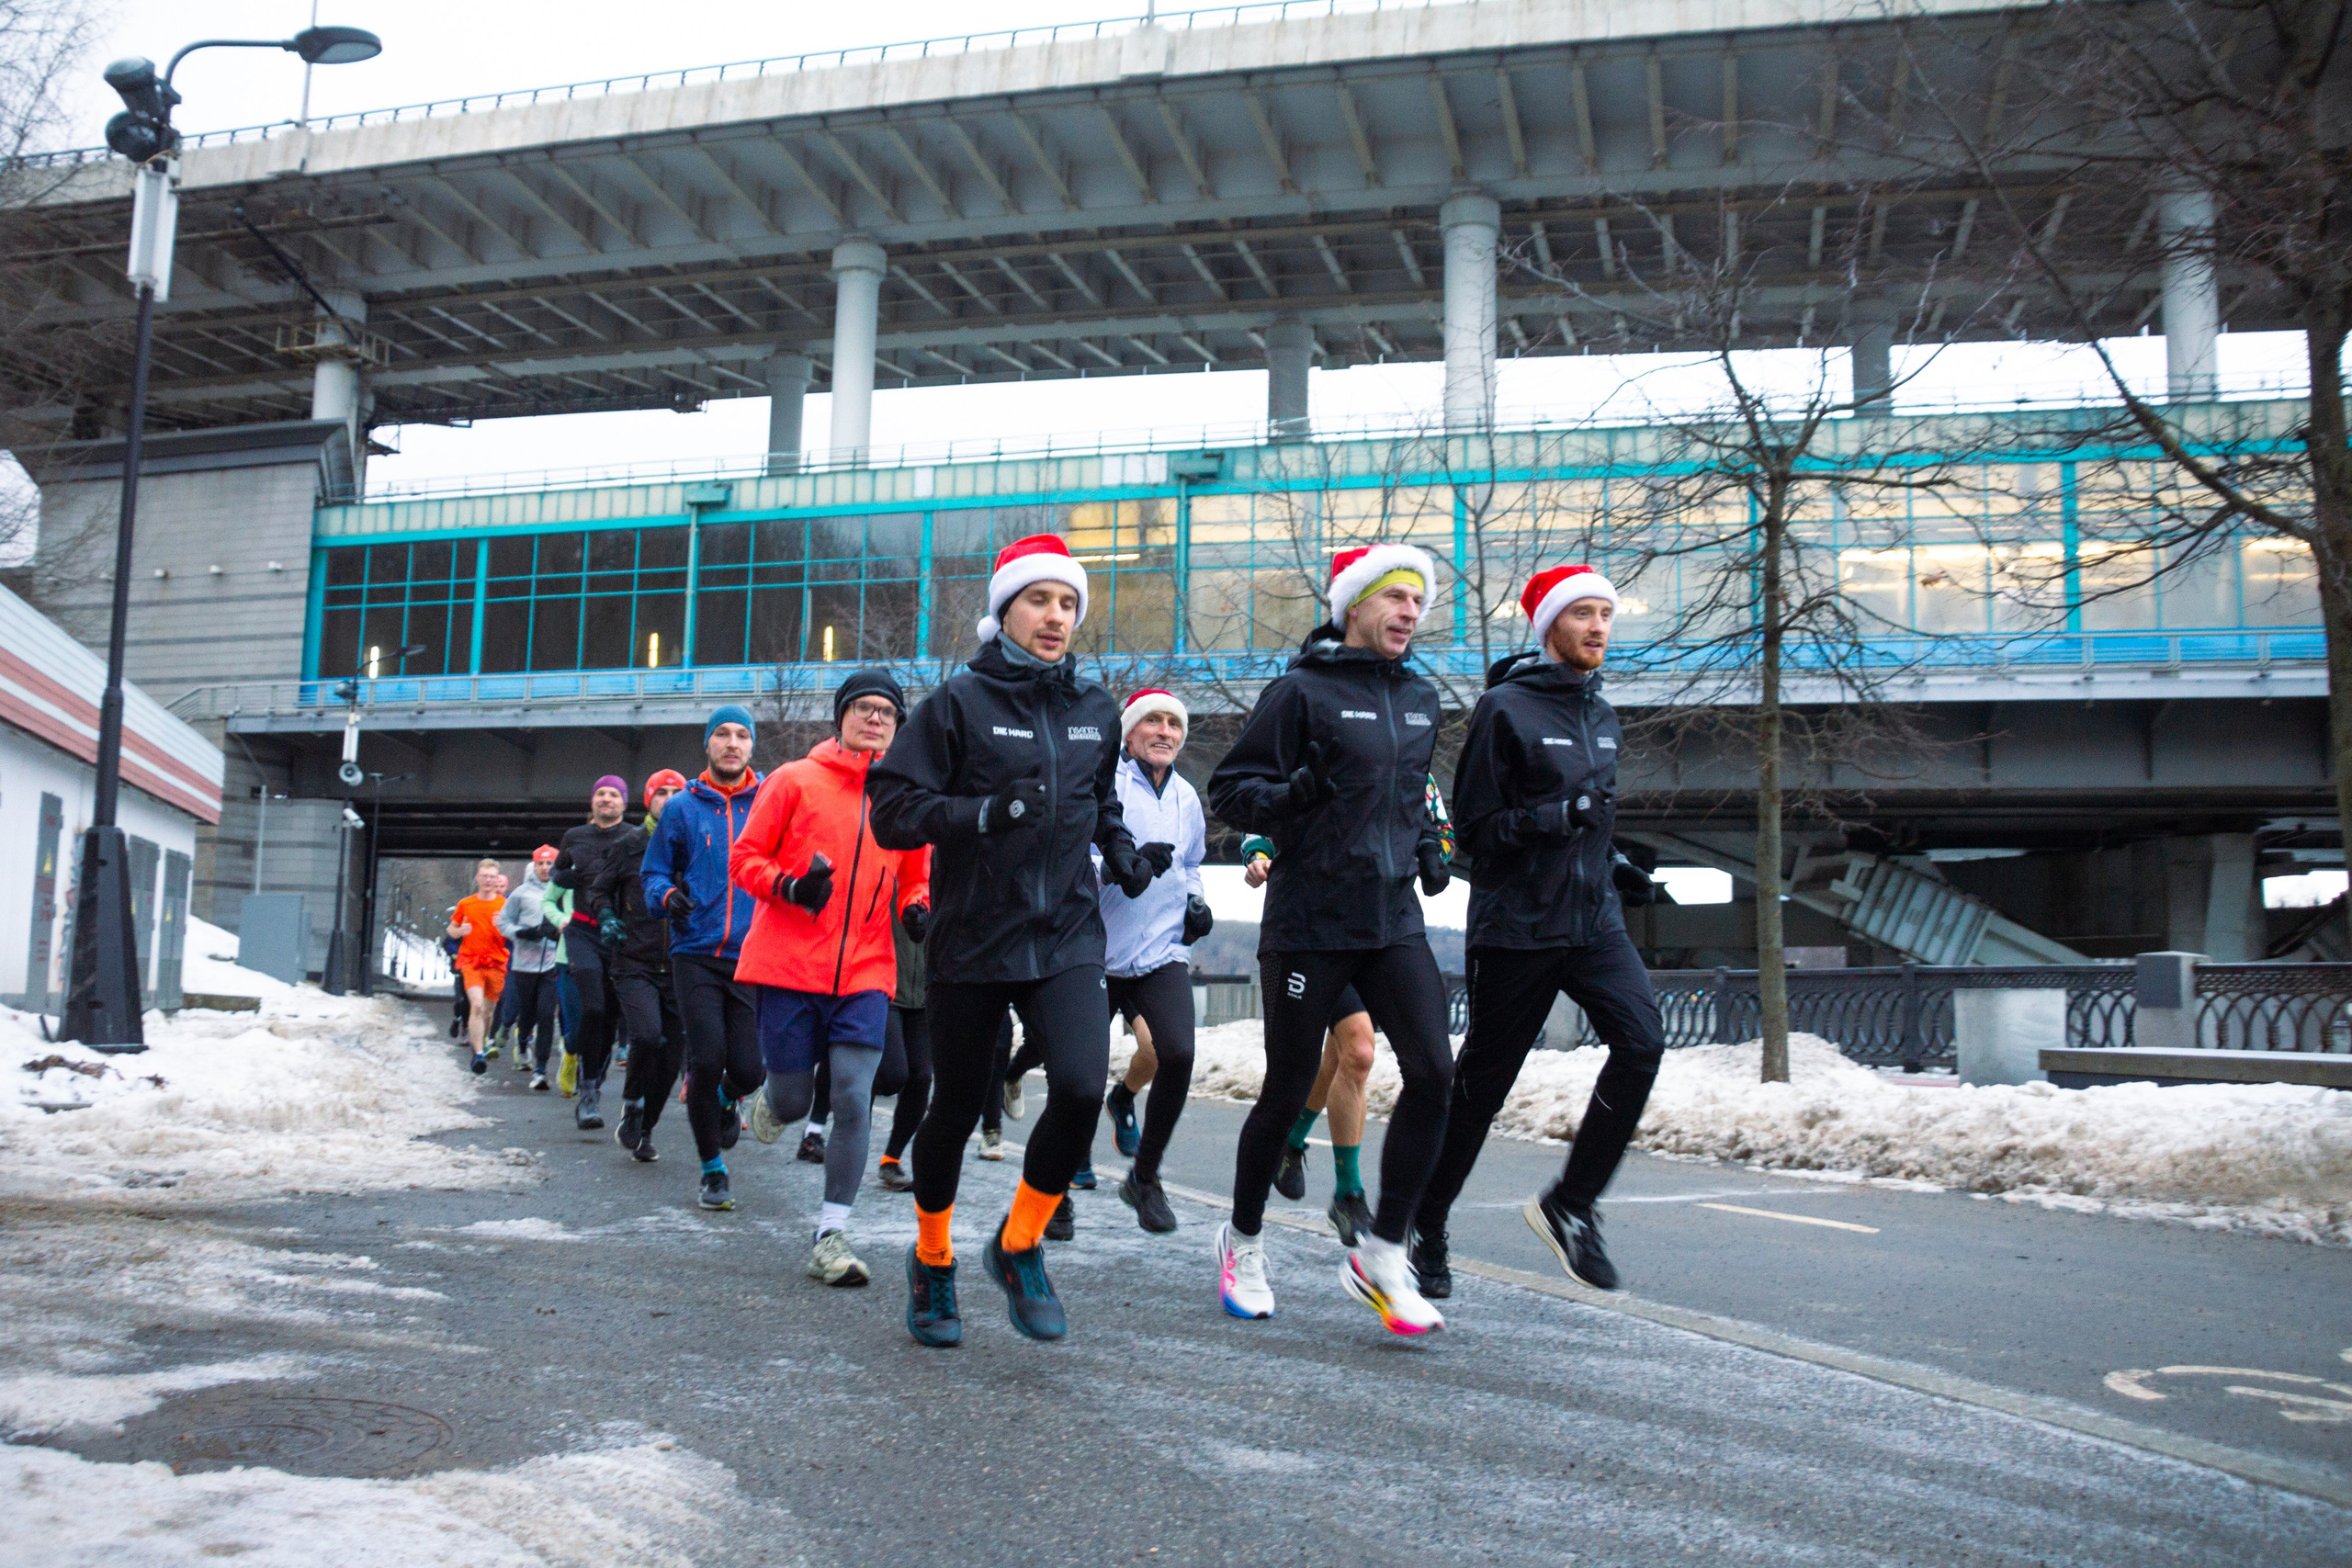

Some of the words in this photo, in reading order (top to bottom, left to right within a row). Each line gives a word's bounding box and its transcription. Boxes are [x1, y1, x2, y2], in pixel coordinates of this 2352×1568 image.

[1340, 710, 1355, 719] DIE
[1355, 711, 1377, 720] HARD
[992, 726, 1008, 736] DIE
[1008, 728, 1034, 739] HARD
